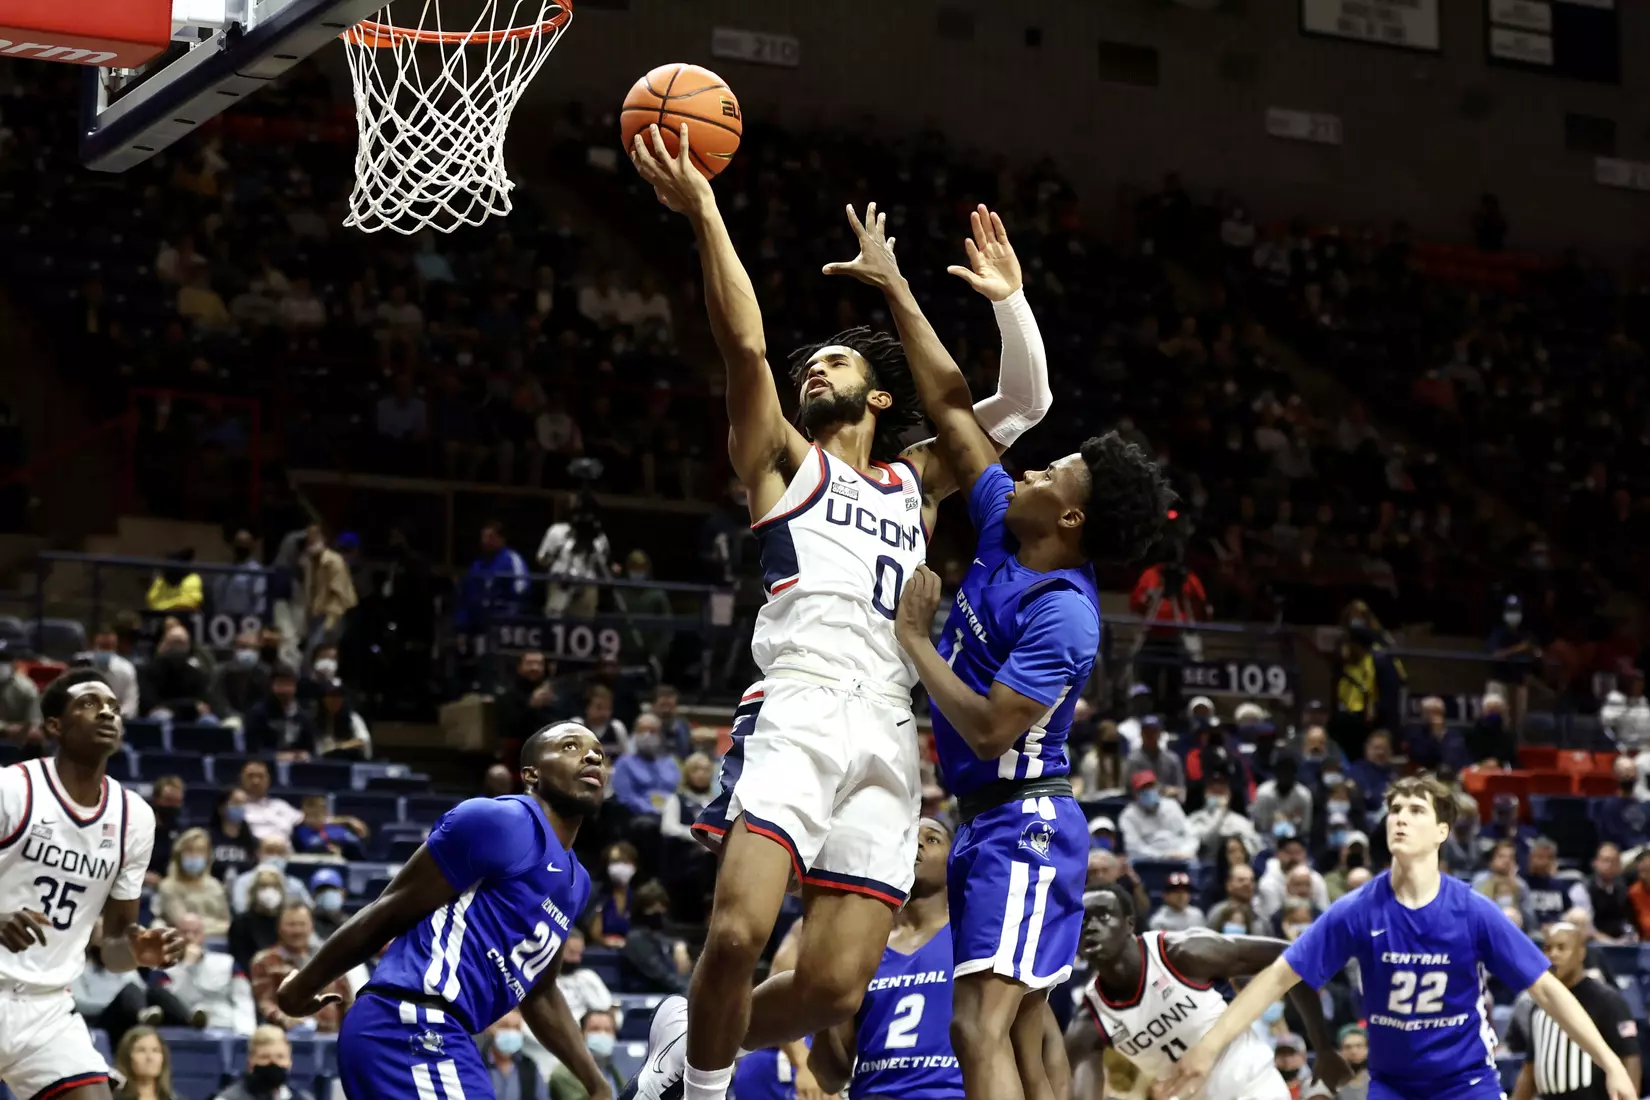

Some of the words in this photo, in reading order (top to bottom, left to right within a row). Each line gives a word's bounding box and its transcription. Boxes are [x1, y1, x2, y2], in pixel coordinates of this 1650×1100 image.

[872, 555, 904, 620] 0
[500, 625, 542, 646] SEC
[551, 624, 621, 661] 109
[1182, 665, 1219, 686] SEC
[1225, 661, 1287, 696] 109
[22, 838, 115, 880] UCONN
[34, 876, 88, 930] 35
[510, 920, 562, 982] 20
[1381, 951, 1451, 965] CENTRAL
[867, 970, 947, 992] CENTRAL
[1387, 970, 1448, 1015] 22
[884, 993, 925, 1050] 2
[1118, 995, 1198, 1056] UCONN
[1369, 1012, 1469, 1031] CONNECTICUT
[858, 1055, 961, 1074] ONNECTICUT
[1161, 1037, 1188, 1063] 11
